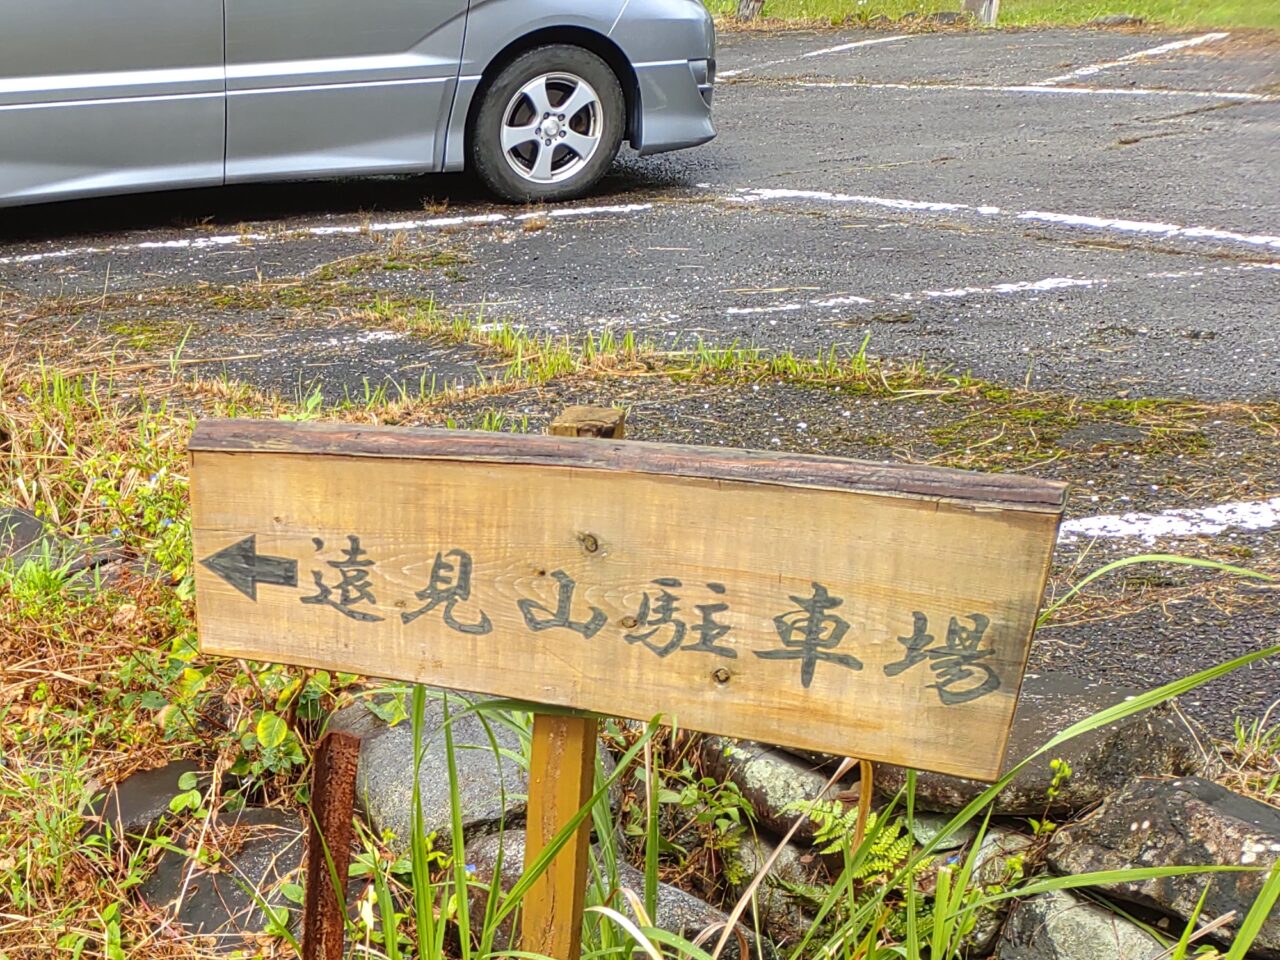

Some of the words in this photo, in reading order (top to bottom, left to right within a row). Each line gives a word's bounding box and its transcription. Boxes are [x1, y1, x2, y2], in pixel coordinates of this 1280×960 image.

[299, 534, 1002, 706] 遠見山駐車場
